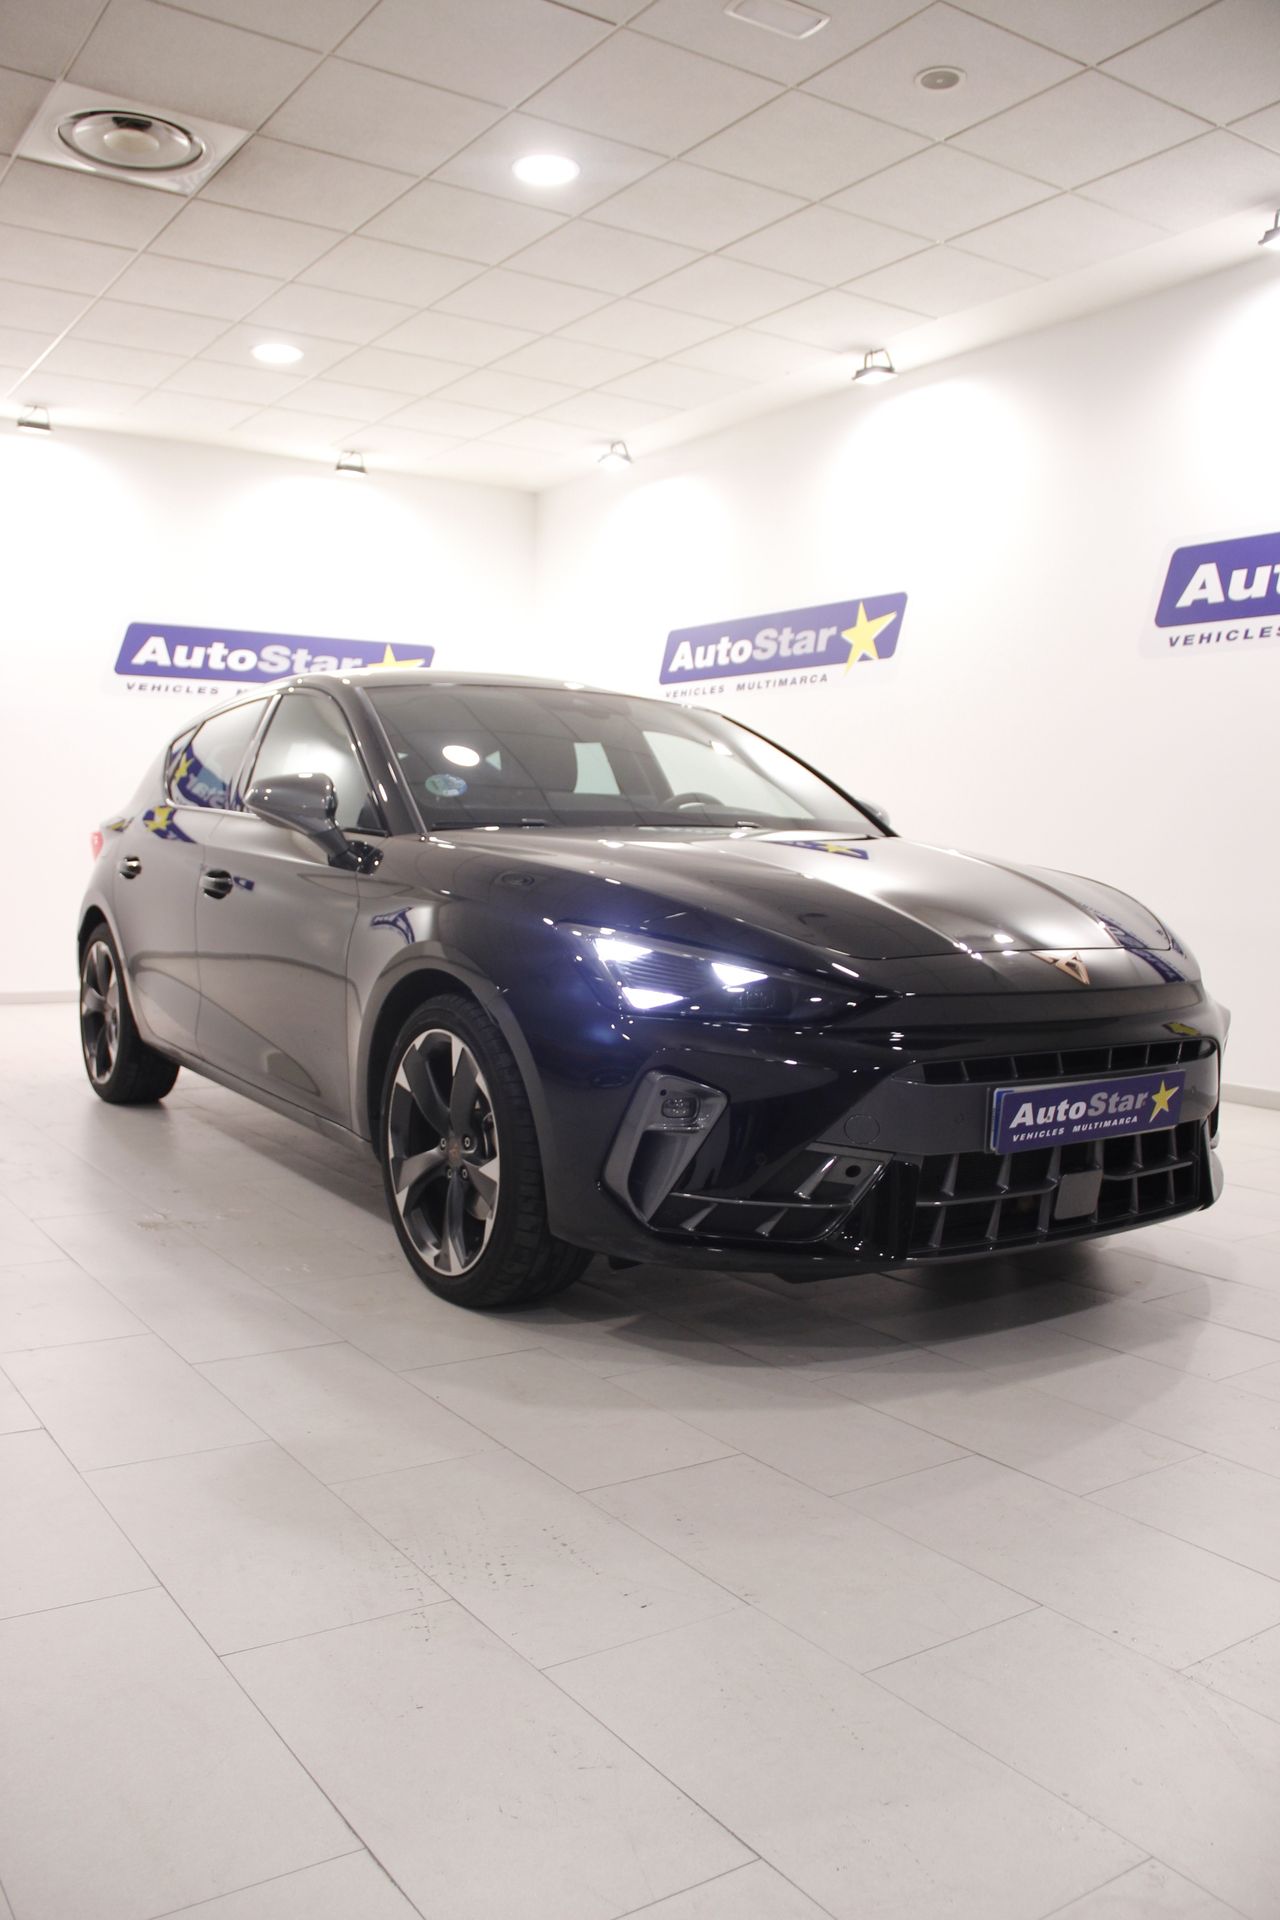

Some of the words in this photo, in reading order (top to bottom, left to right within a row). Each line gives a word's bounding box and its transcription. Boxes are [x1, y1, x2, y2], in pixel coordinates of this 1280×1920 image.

[131, 636, 363, 674] AutoStar
[668, 626, 837, 672] AutoStar
[126, 682, 219, 695] VEHICLES
[665, 684, 725, 698] VEHICLES
[736, 673, 828, 692] MULTIMARCA
[1009, 1091, 1148, 1129] AutoStar
[1012, 1127, 1065, 1142] VEHICLES
[1072, 1115, 1138, 1133] MULTIMARCA
